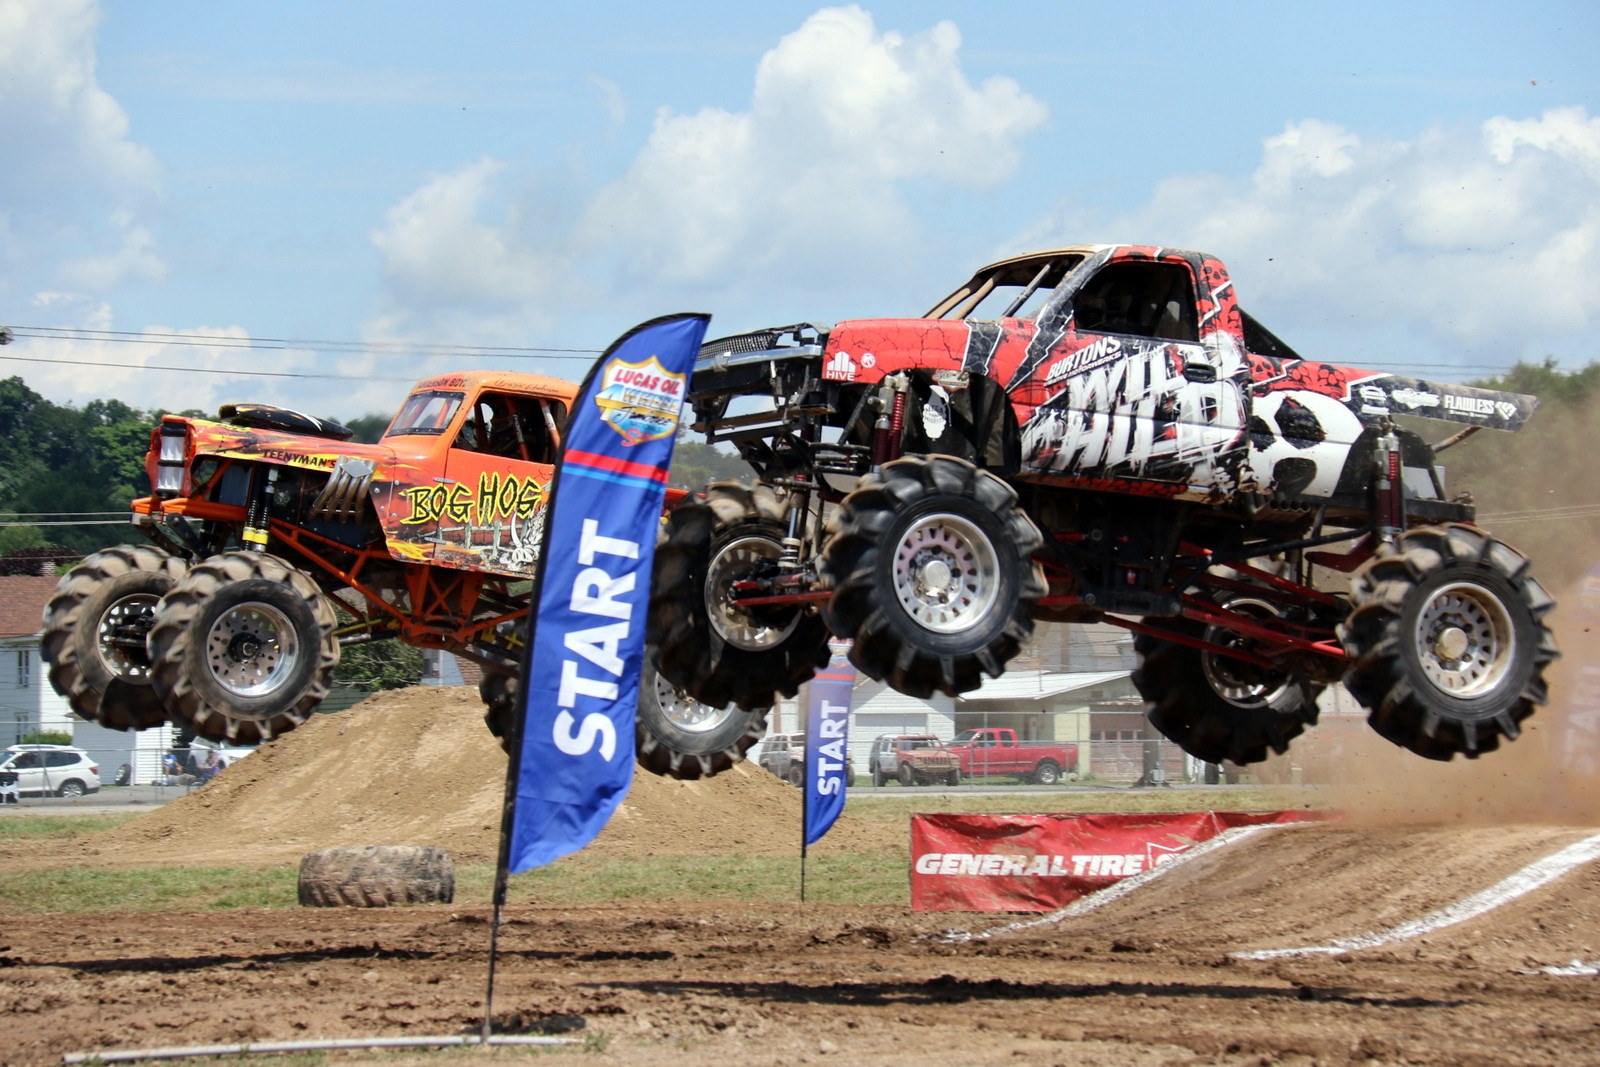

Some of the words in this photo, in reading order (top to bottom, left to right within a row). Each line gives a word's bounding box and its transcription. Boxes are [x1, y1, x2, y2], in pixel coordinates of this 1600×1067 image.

[1045, 336, 1122, 381] BURTONS
[614, 369, 660, 390] LUCAS
[661, 379, 680, 395] OIL
[826, 370, 855, 381] HIVE
[1444, 394, 1495, 415] FLAWLESS
[263, 449, 338, 468] TEENYMAN'S
[399, 482, 475, 524] BOG
[477, 471, 542, 526] HOG
[552, 518, 640, 762] START
[817, 700, 848, 796] START
[915, 853, 1067, 876] GENERAL
[1070, 854, 1146, 876] TIRE
